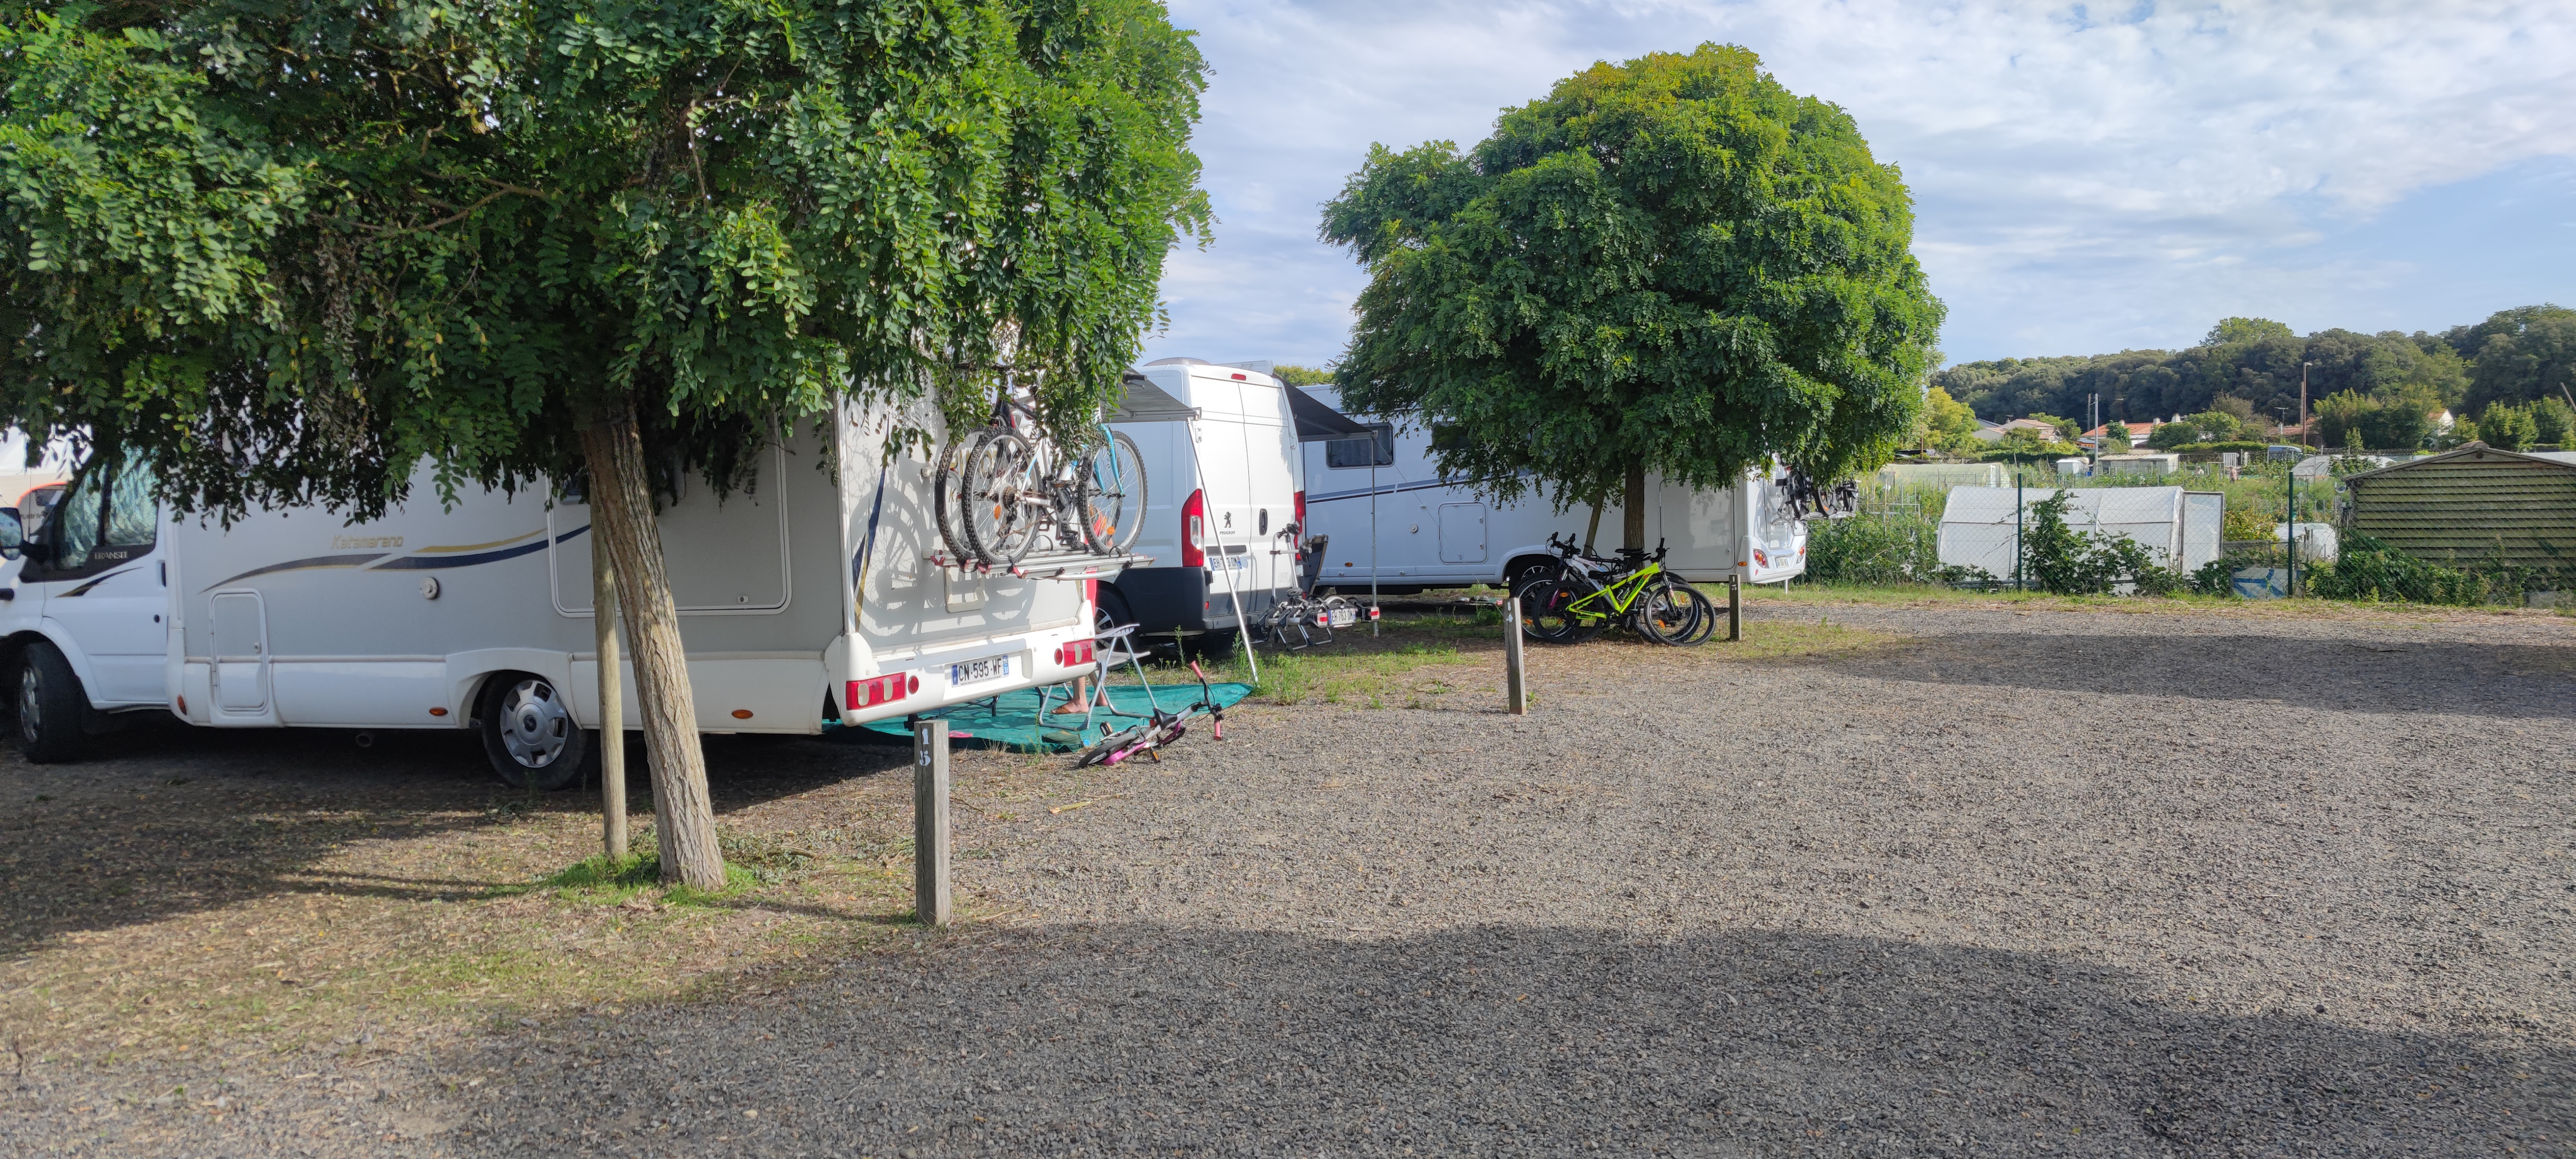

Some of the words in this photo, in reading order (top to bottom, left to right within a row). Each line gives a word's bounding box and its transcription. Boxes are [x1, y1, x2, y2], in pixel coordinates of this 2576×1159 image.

[331, 534, 404, 549] Katamarano
[94, 551, 127, 560] TRANSIT
[958, 658, 1002, 682] CN-595-WF
